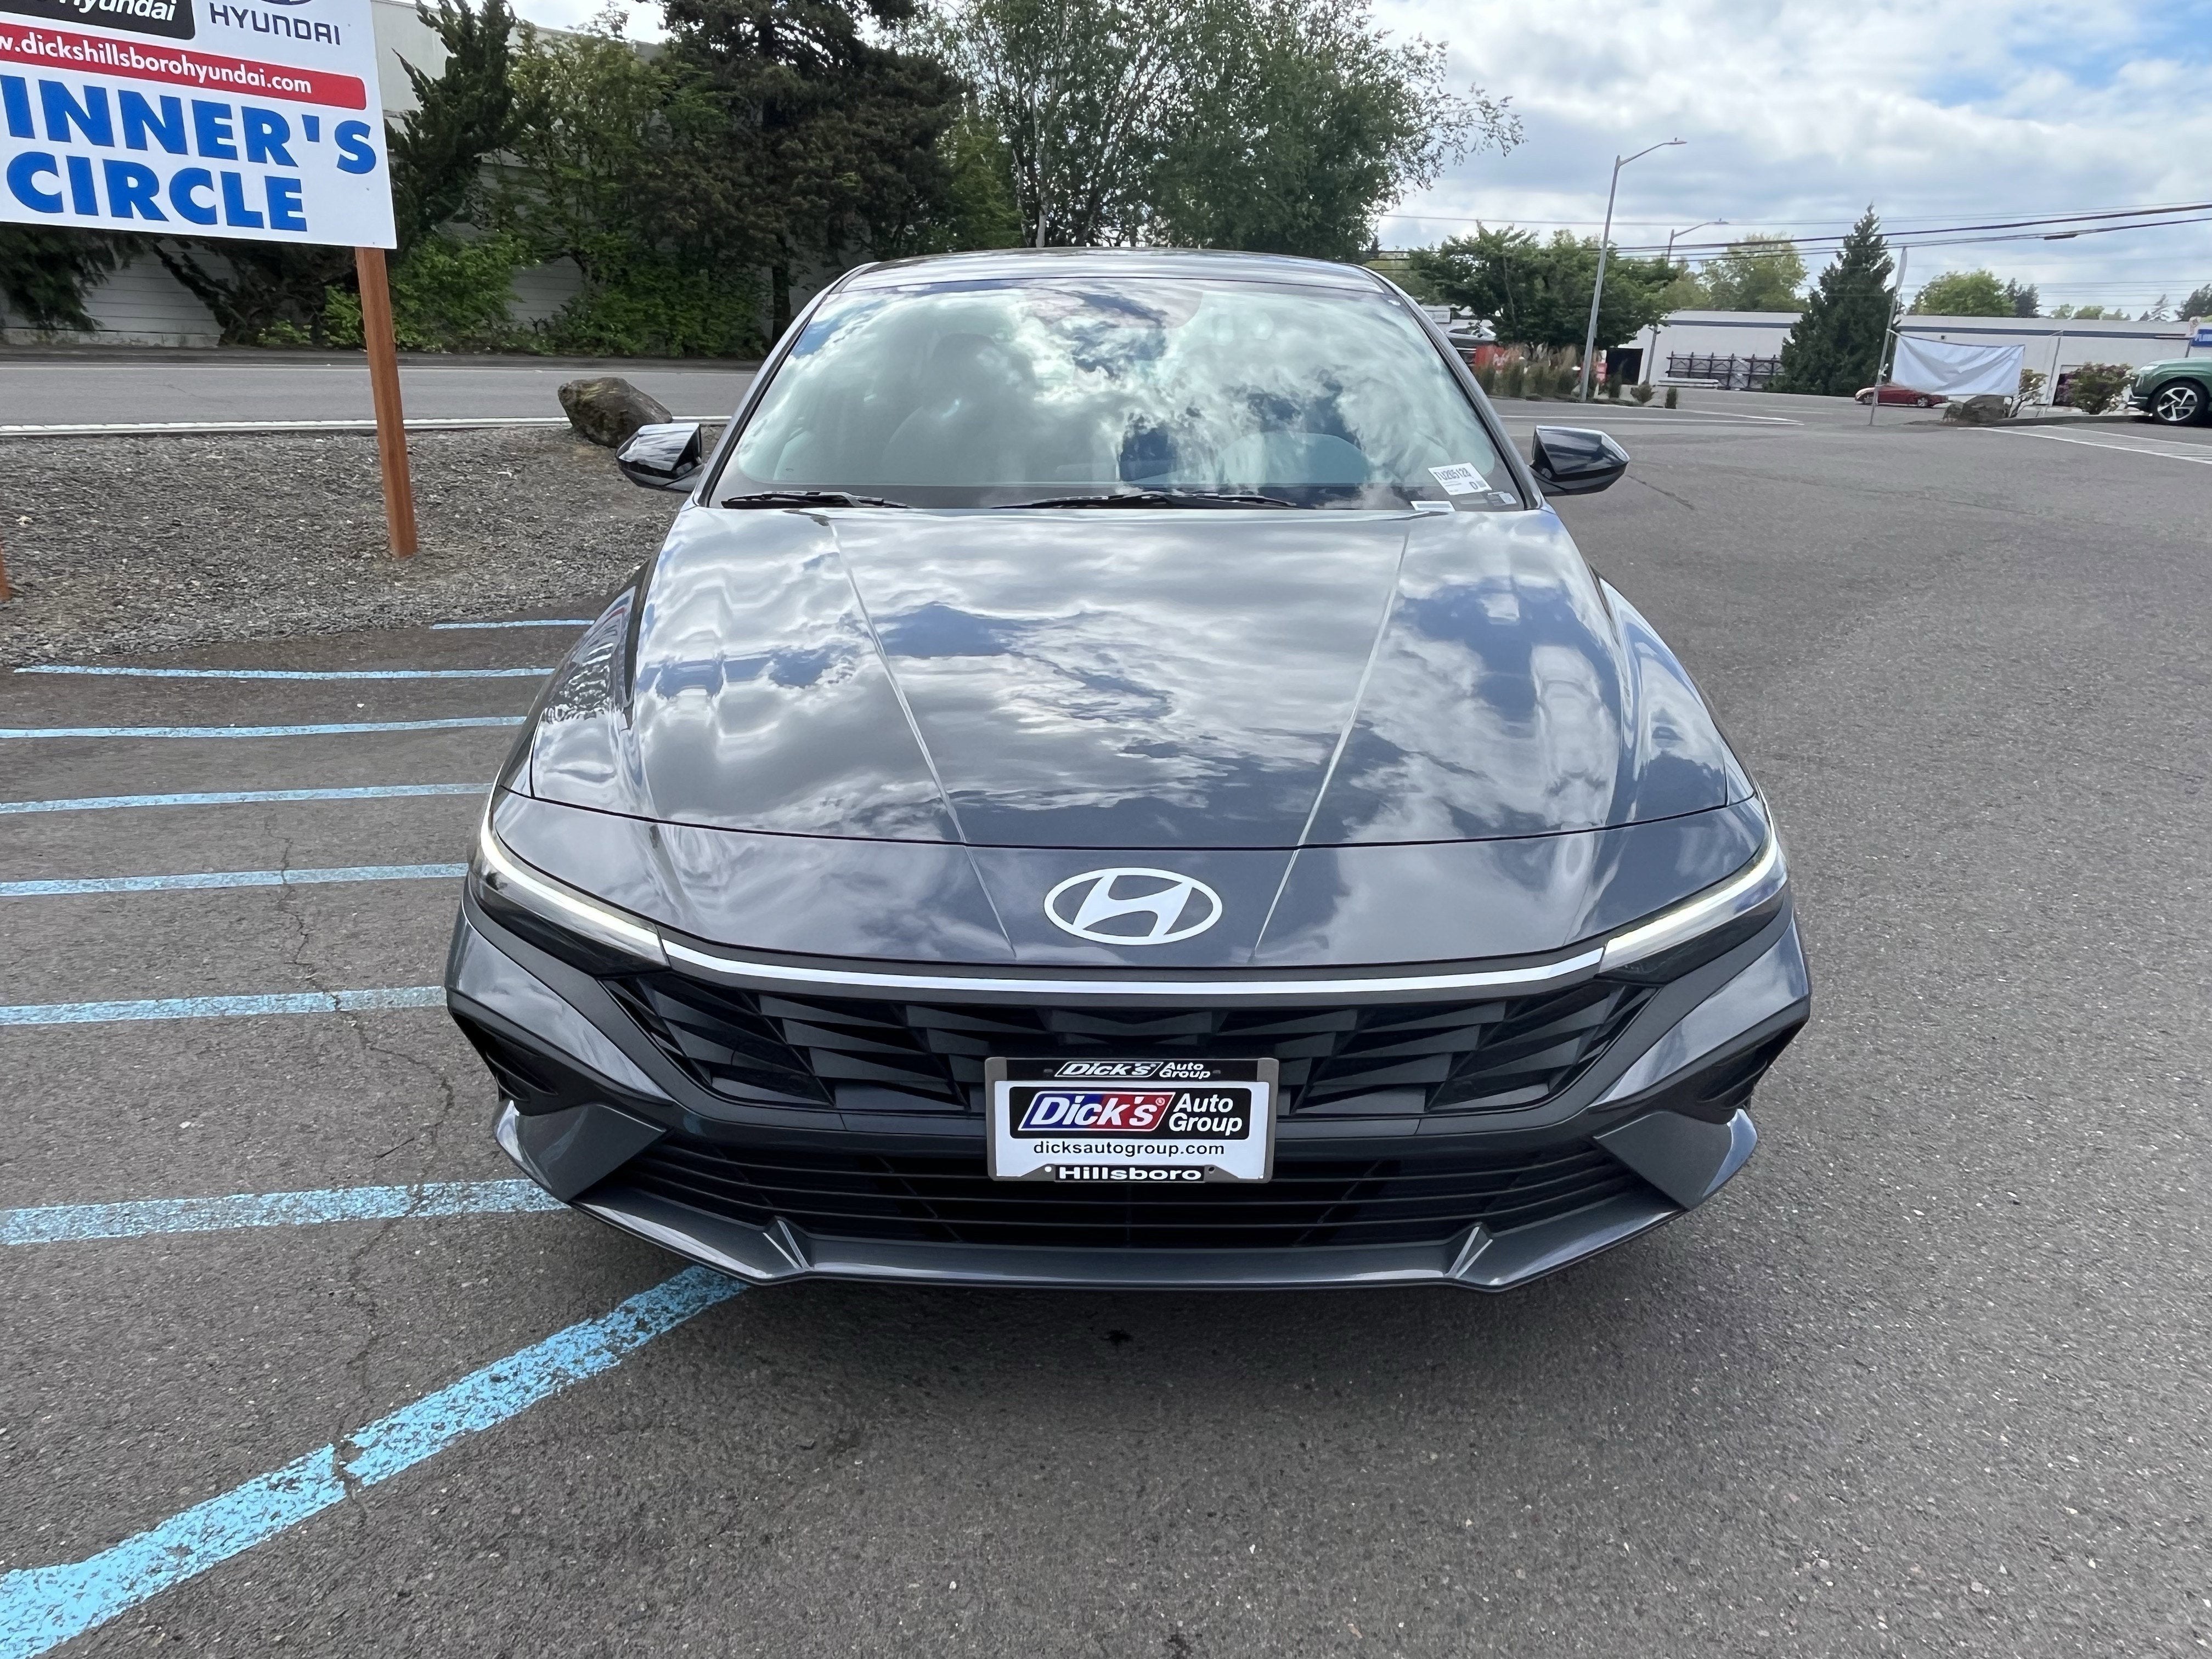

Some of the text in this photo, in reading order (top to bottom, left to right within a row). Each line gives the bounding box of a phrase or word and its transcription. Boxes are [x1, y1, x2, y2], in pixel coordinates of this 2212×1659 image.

[59, 0, 177, 21] yundai
[210, 2, 341, 46] HYUNDAI
[7, 151, 308, 232] CIRCLE
[1159, 1069, 1211, 1080] Group
[1163, 1062, 1204, 1070] Auto
[1173, 1093, 1233, 1113] Auto
[1169, 1112, 1243, 1136] Group
[1033, 1141, 1224, 1157] dicksautogroup.com
[1059, 1167, 1201, 1180] Hillsboro
